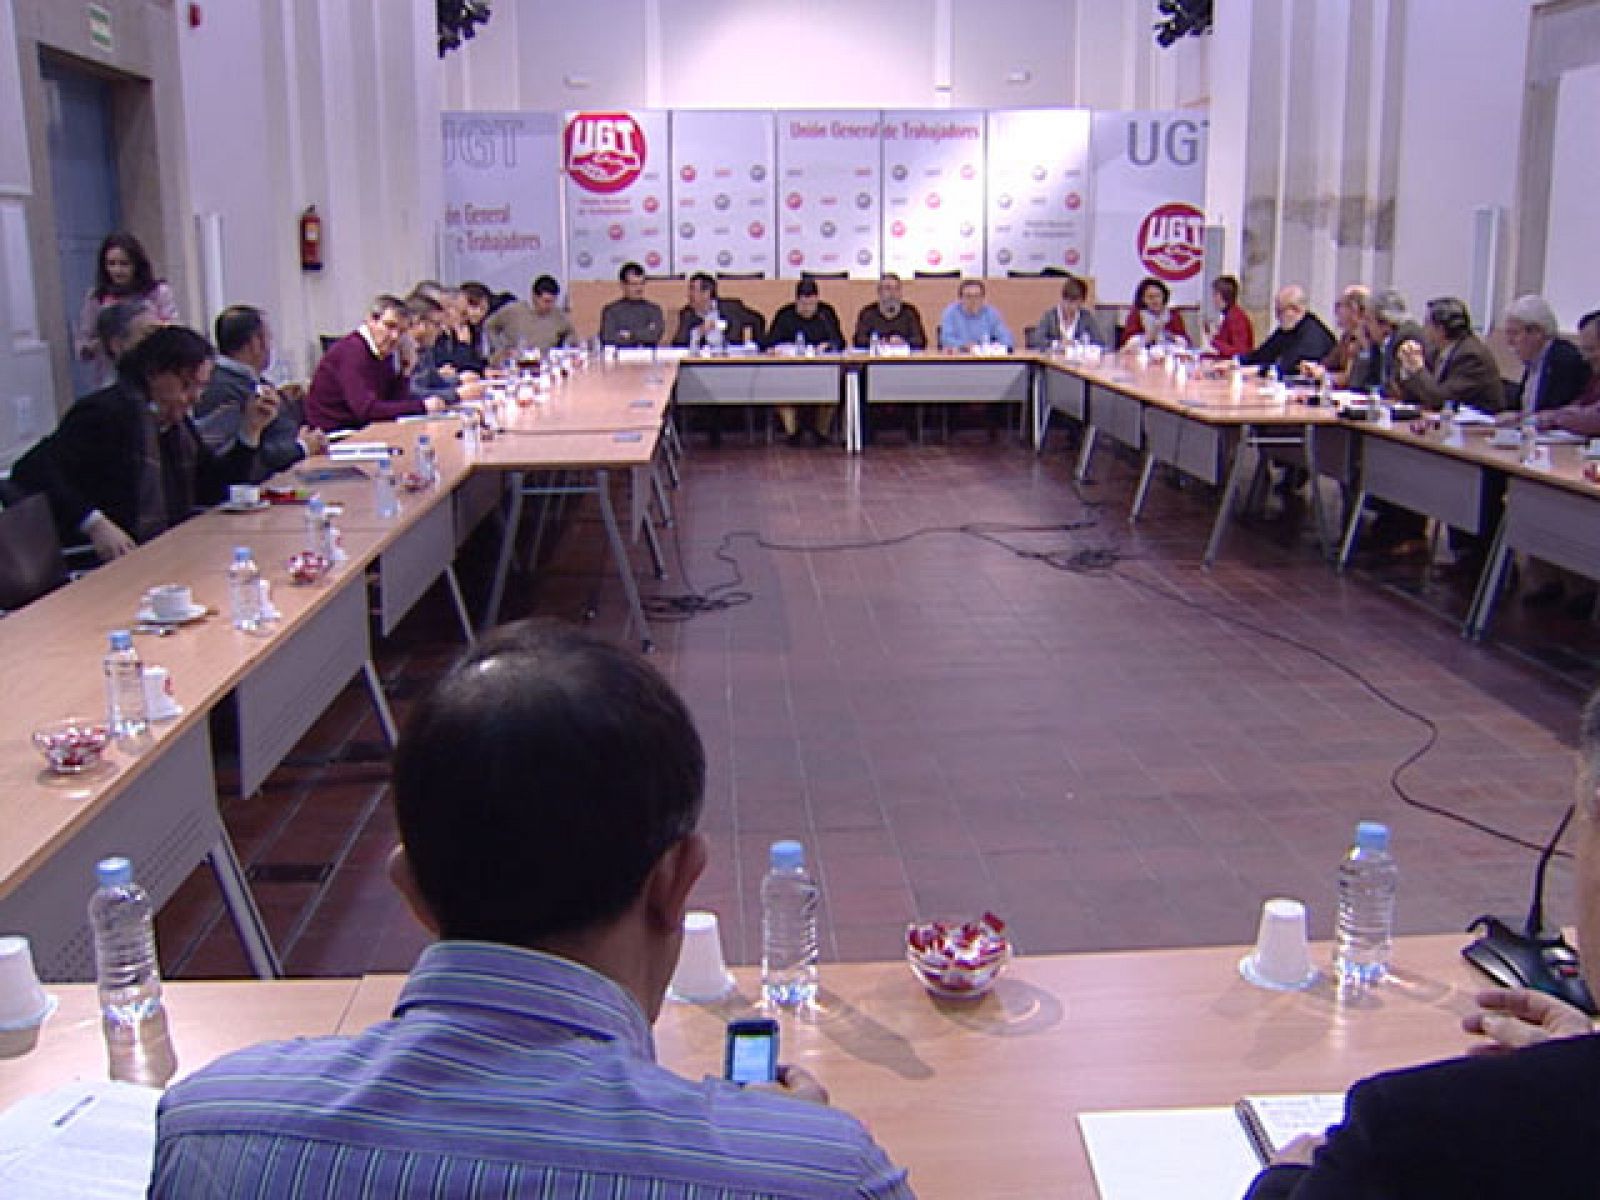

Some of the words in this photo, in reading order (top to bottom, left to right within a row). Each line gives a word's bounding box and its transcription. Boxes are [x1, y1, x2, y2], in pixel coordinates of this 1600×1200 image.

[572, 119, 635, 155] UGT
[831, 120, 880, 140] General
[883, 122, 898, 141] de
[902, 121, 980, 145] Trabajadores
[1147, 215, 1204, 248] UGT
